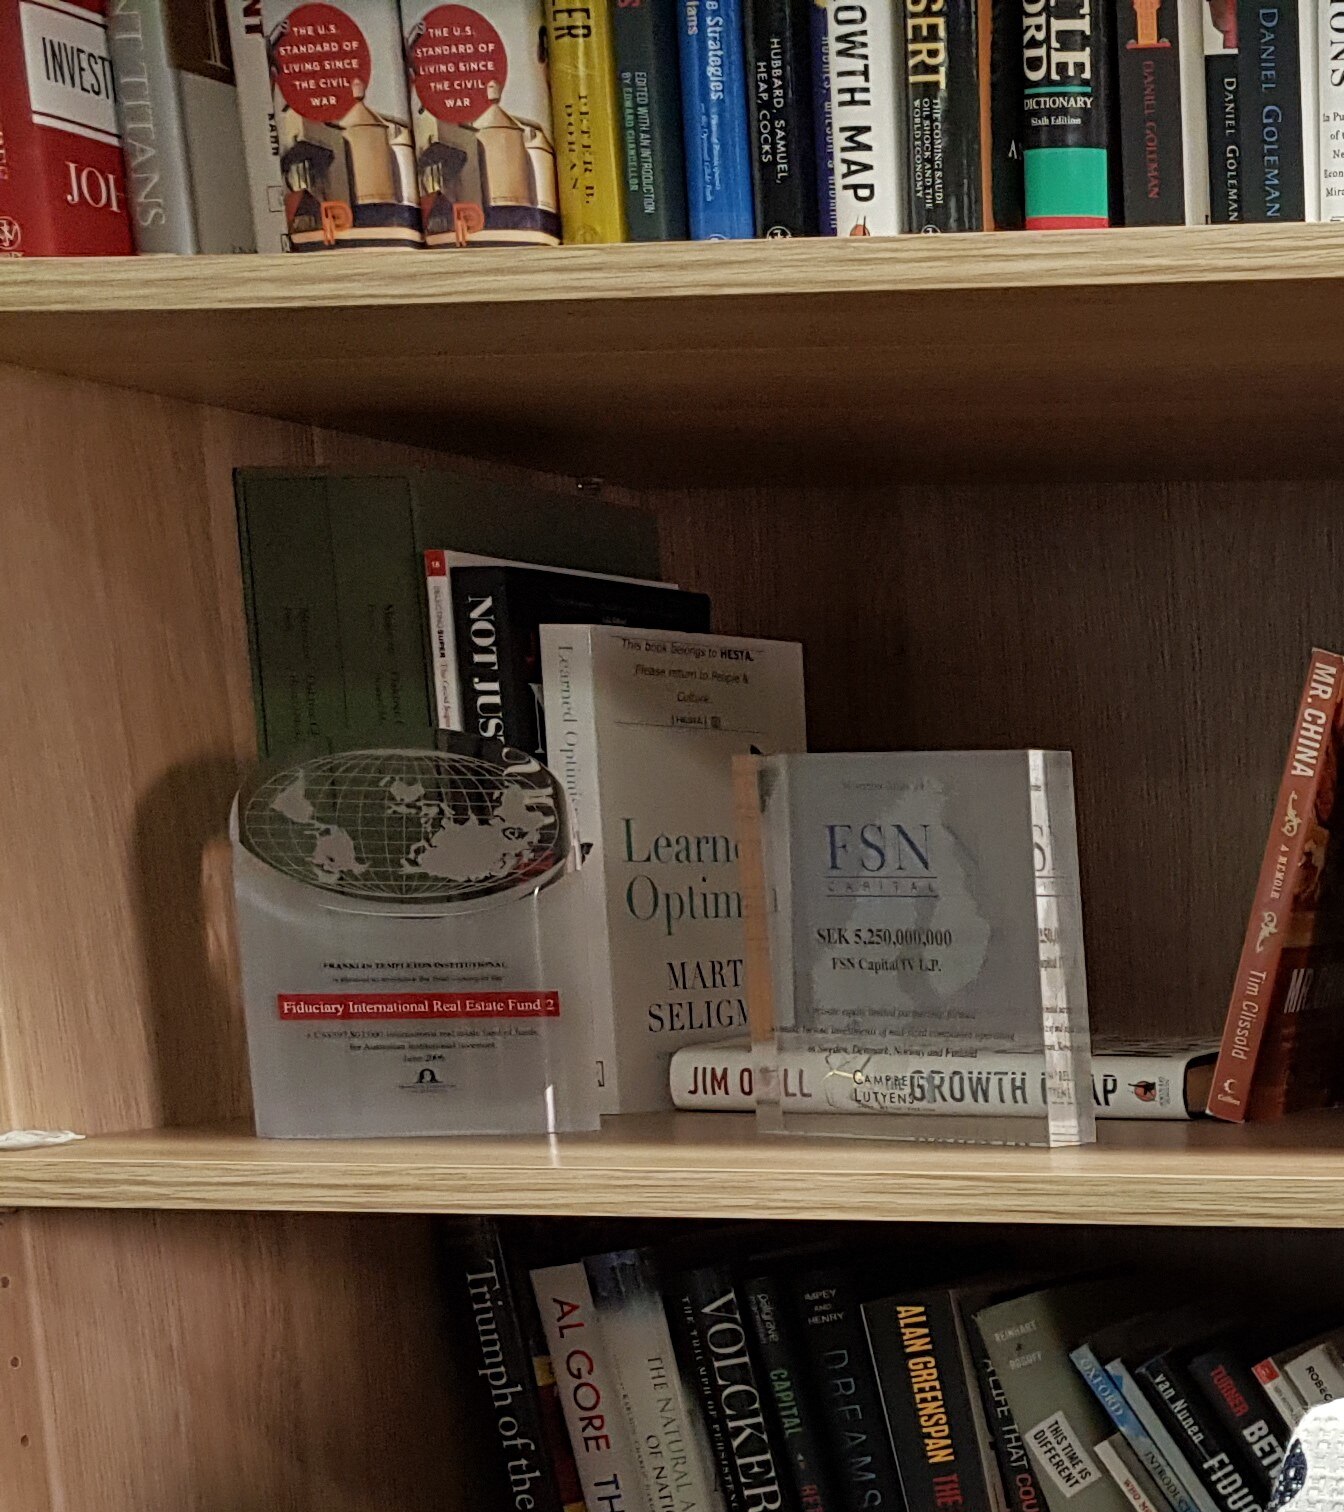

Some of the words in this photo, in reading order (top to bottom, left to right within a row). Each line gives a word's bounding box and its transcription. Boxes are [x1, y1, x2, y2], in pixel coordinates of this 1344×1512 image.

[280, 42, 339, 55] STANDARD
[416, 43, 476, 57] STANDARD
[478, 43, 495, 53] OF
[429, 27, 450, 37] THE
[1259, 8, 1278, 92] DANIEL
[283, 61, 320, 74] LIVING
[324, 59, 358, 70] SINCE
[319, 77, 350, 88] CIVIL
[419, 62, 455, 75] LIVING
[458, 61, 494, 72] SINCE
[430, 80, 451, 91] THE
[454, 79, 485, 90] CIVIL
[756, 61, 770, 104] HEAP,
[1142, 61, 1156, 114] DANIEL
[310, 95, 337, 106] WAR
[445, 97, 470, 108] WAR
[1025, 96, 1093, 110] DICTIONARY
[1051, 116, 1081, 126] Edition
[1223, 77, 1238, 136] DANIEL
[758, 110, 773, 163] COCKS
[776, 119, 789, 184] SAMUEL,
[932, 122, 943, 169] COMING
[1262, 105, 1281, 217] GOLEMAN
[839, 125, 876, 203] MAP
[914, 141, 924, 198] ECONOMY
[1226, 145, 1240, 222] GOLEMAN
[467, 595, 498, 672] NOT
[1290, 706, 1328, 778] CHINA
[824, 823, 932, 873] FSN
[283, 1000, 345, 1017] Fiduciary
[348, 1000, 430, 1014] International
[433, 1000, 462, 1013] Real
[465, 1000, 504, 1013] Estate
[508, 999, 542, 1012] Fund
[1231, 1000, 1260, 1061] Clissold
[551, 1296, 585, 1340] AL
[808, 1311, 845, 1325] HENRY
[896, 1305, 932, 1354] ALAN
[466, 1257, 520, 1411] Triumph
[506, 1453, 536, 1512] the
[566, 1349, 612, 1456] GORE
[1209, 1364, 1251, 1419] TURNER
[906, 1356, 955, 1465] GREENSPAN
[1170, 1397, 1205, 1444] Nunen
[655, 1397, 695, 1494] NATURAL
[1001, 1423, 1030, 1469] THAT
[1032, 1429, 1082, 1489] DIFFERENT
